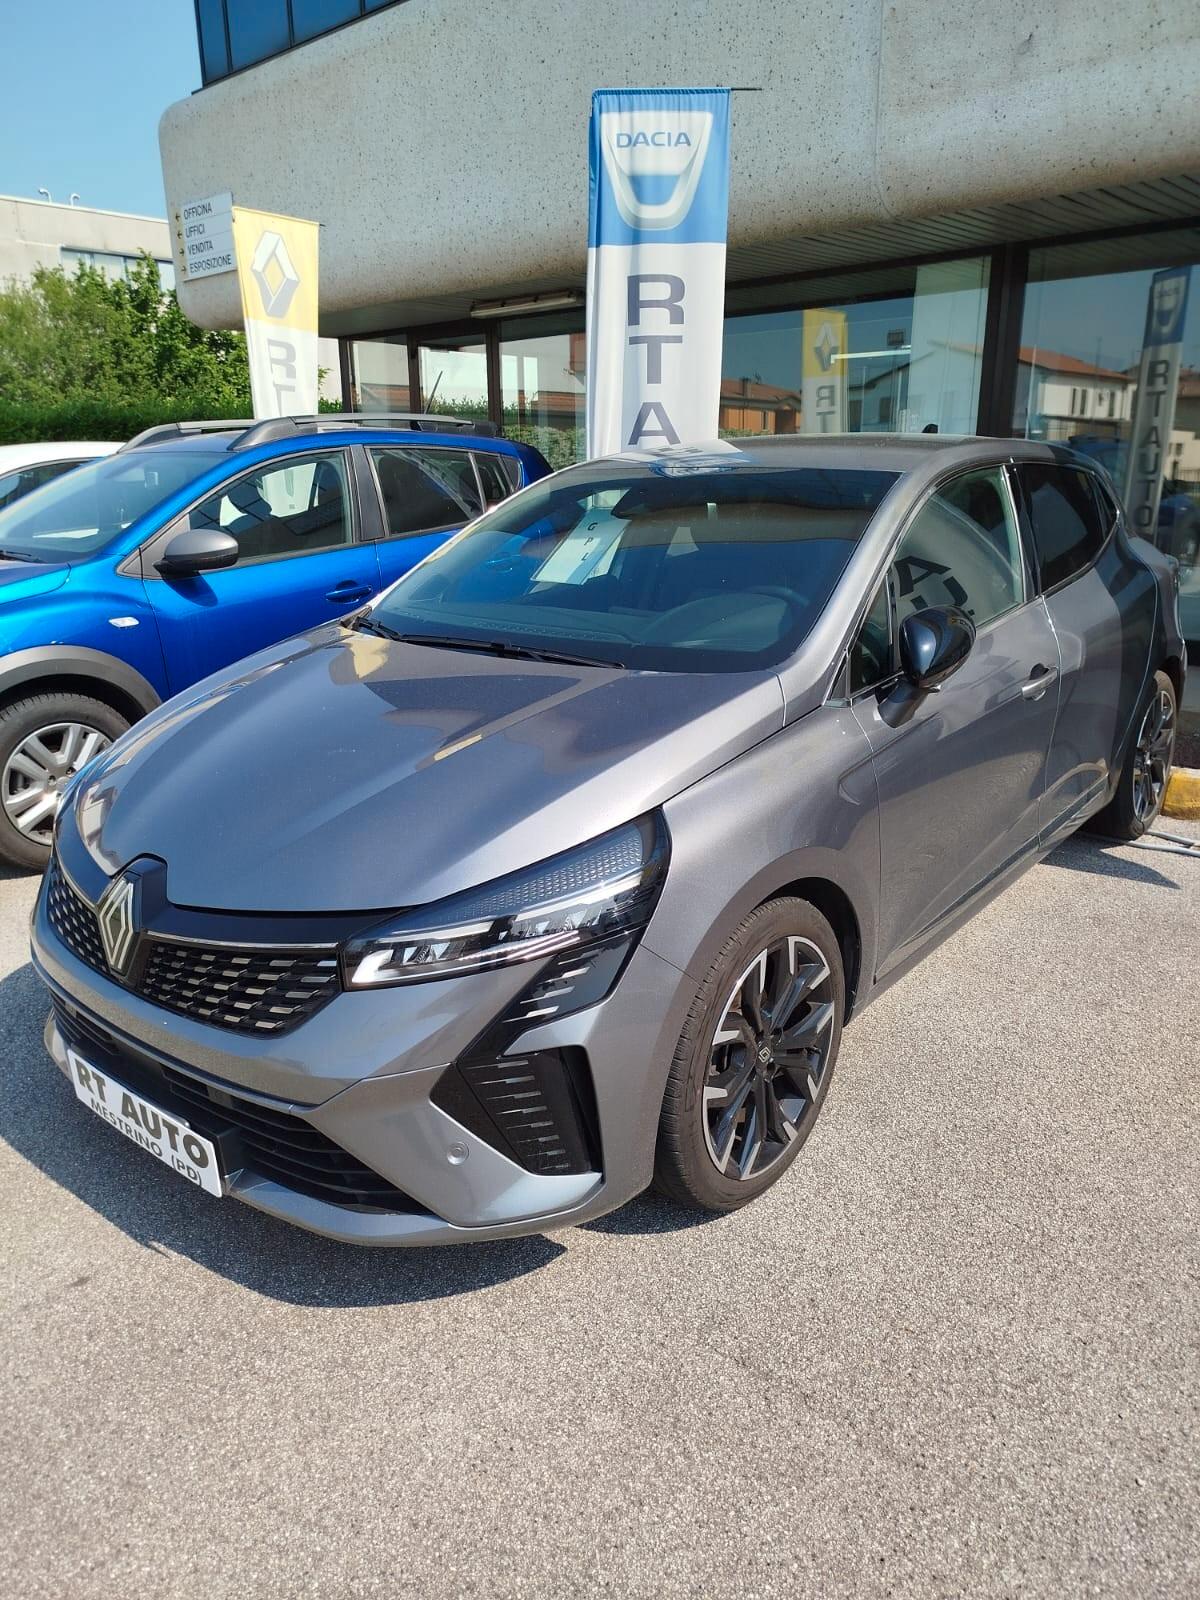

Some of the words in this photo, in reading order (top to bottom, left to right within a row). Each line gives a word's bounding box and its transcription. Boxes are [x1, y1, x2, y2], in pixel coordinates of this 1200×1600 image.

[616, 131, 691, 148] DACIA
[183, 202, 213, 220] OFFICINA
[185, 223, 205, 238] UFFICI
[188, 240, 214, 255] VENDITA
[189, 254, 232, 273] ESPOSIZIONE
[75, 1058, 106, 1103] RT
[121, 1092, 209, 1169] AUTO
[91, 1097, 162, 1157] MESTRINO
[171, 1155, 202, 1188] (PD)
